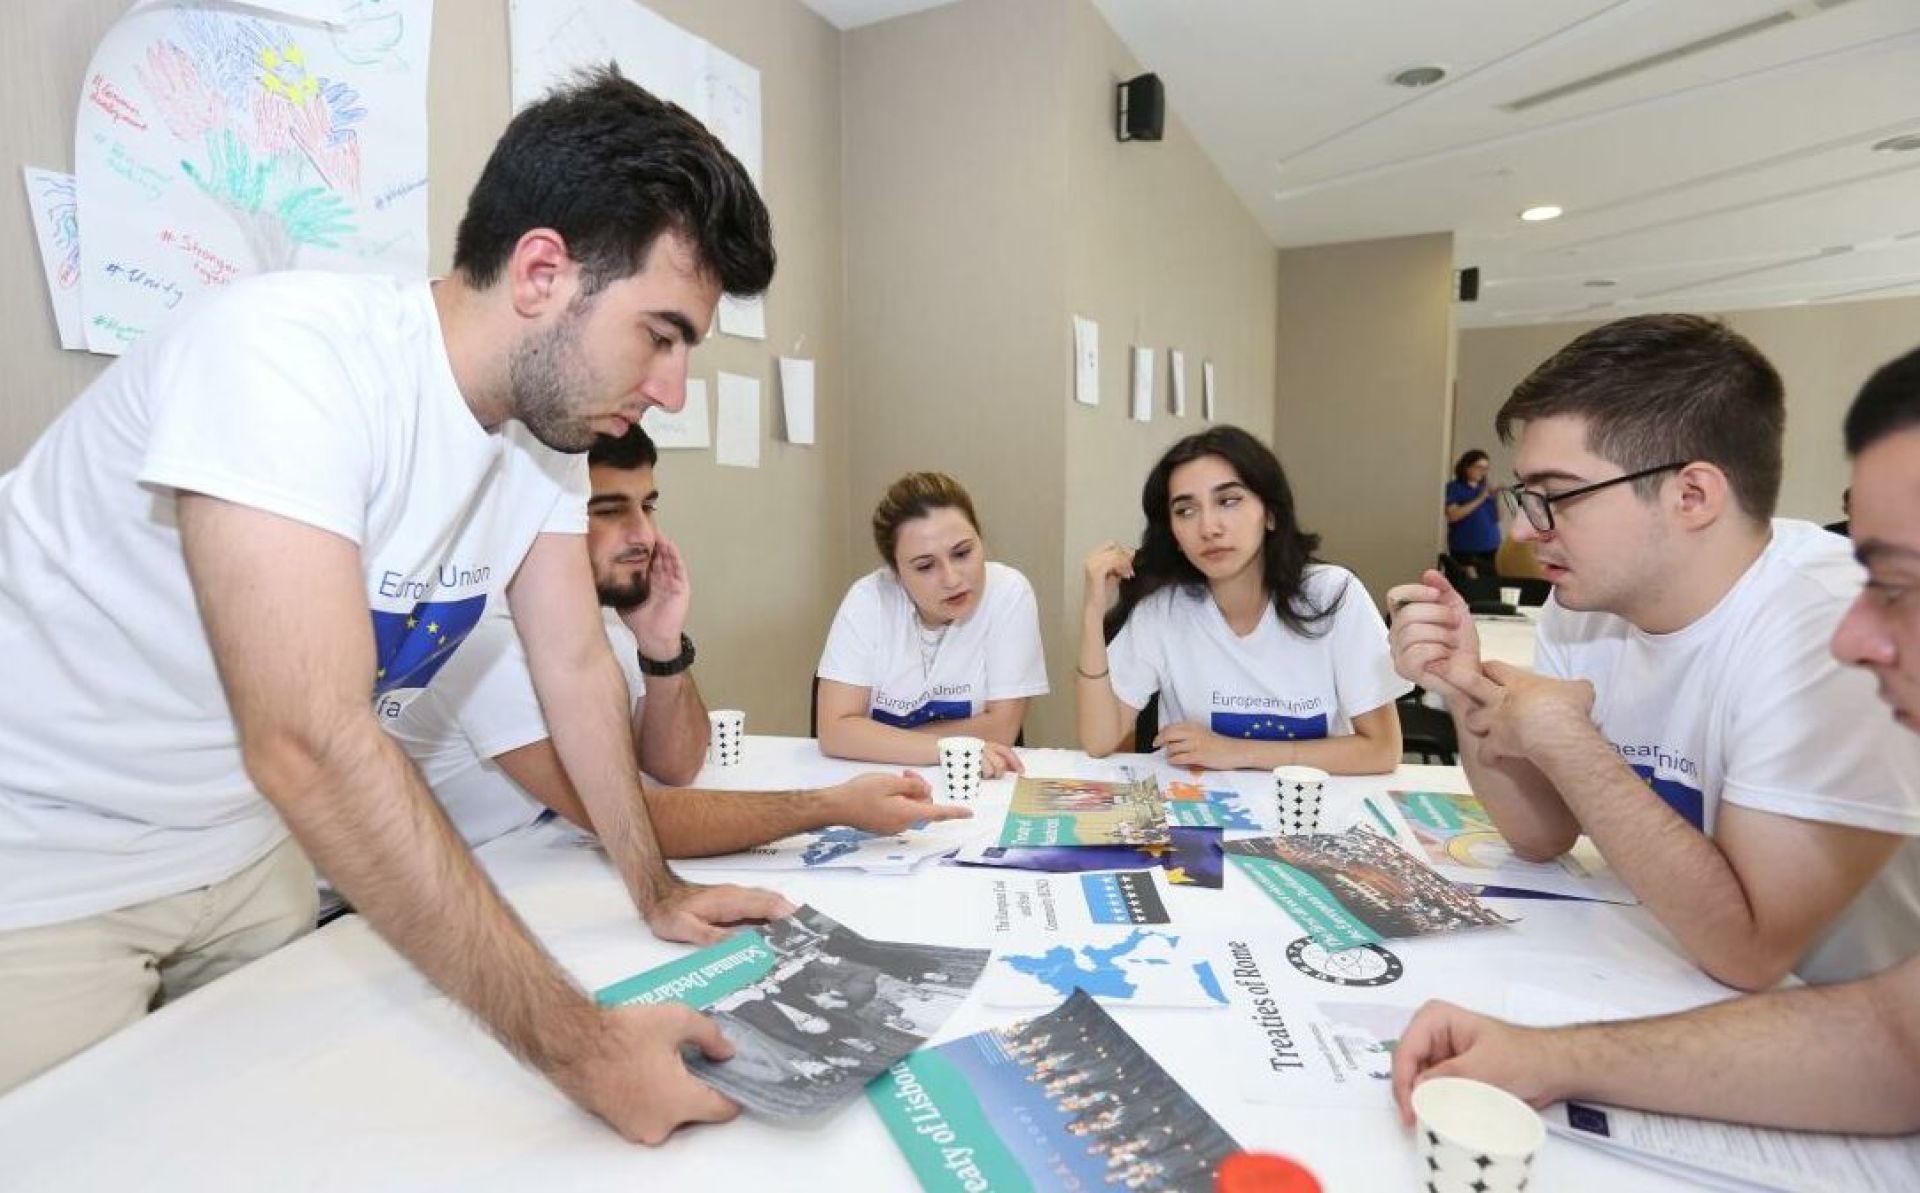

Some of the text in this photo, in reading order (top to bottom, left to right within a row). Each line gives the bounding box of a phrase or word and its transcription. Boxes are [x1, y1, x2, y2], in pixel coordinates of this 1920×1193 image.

[440, 564, 491, 588] Union
[1212, 691, 1280, 709] European
[622, 945, 768, 1006] Schuman Declara
[1228, 939, 1304, 1072] Treaties of Rome
[889, 1060, 994, 1193] eaty of Lisbon
